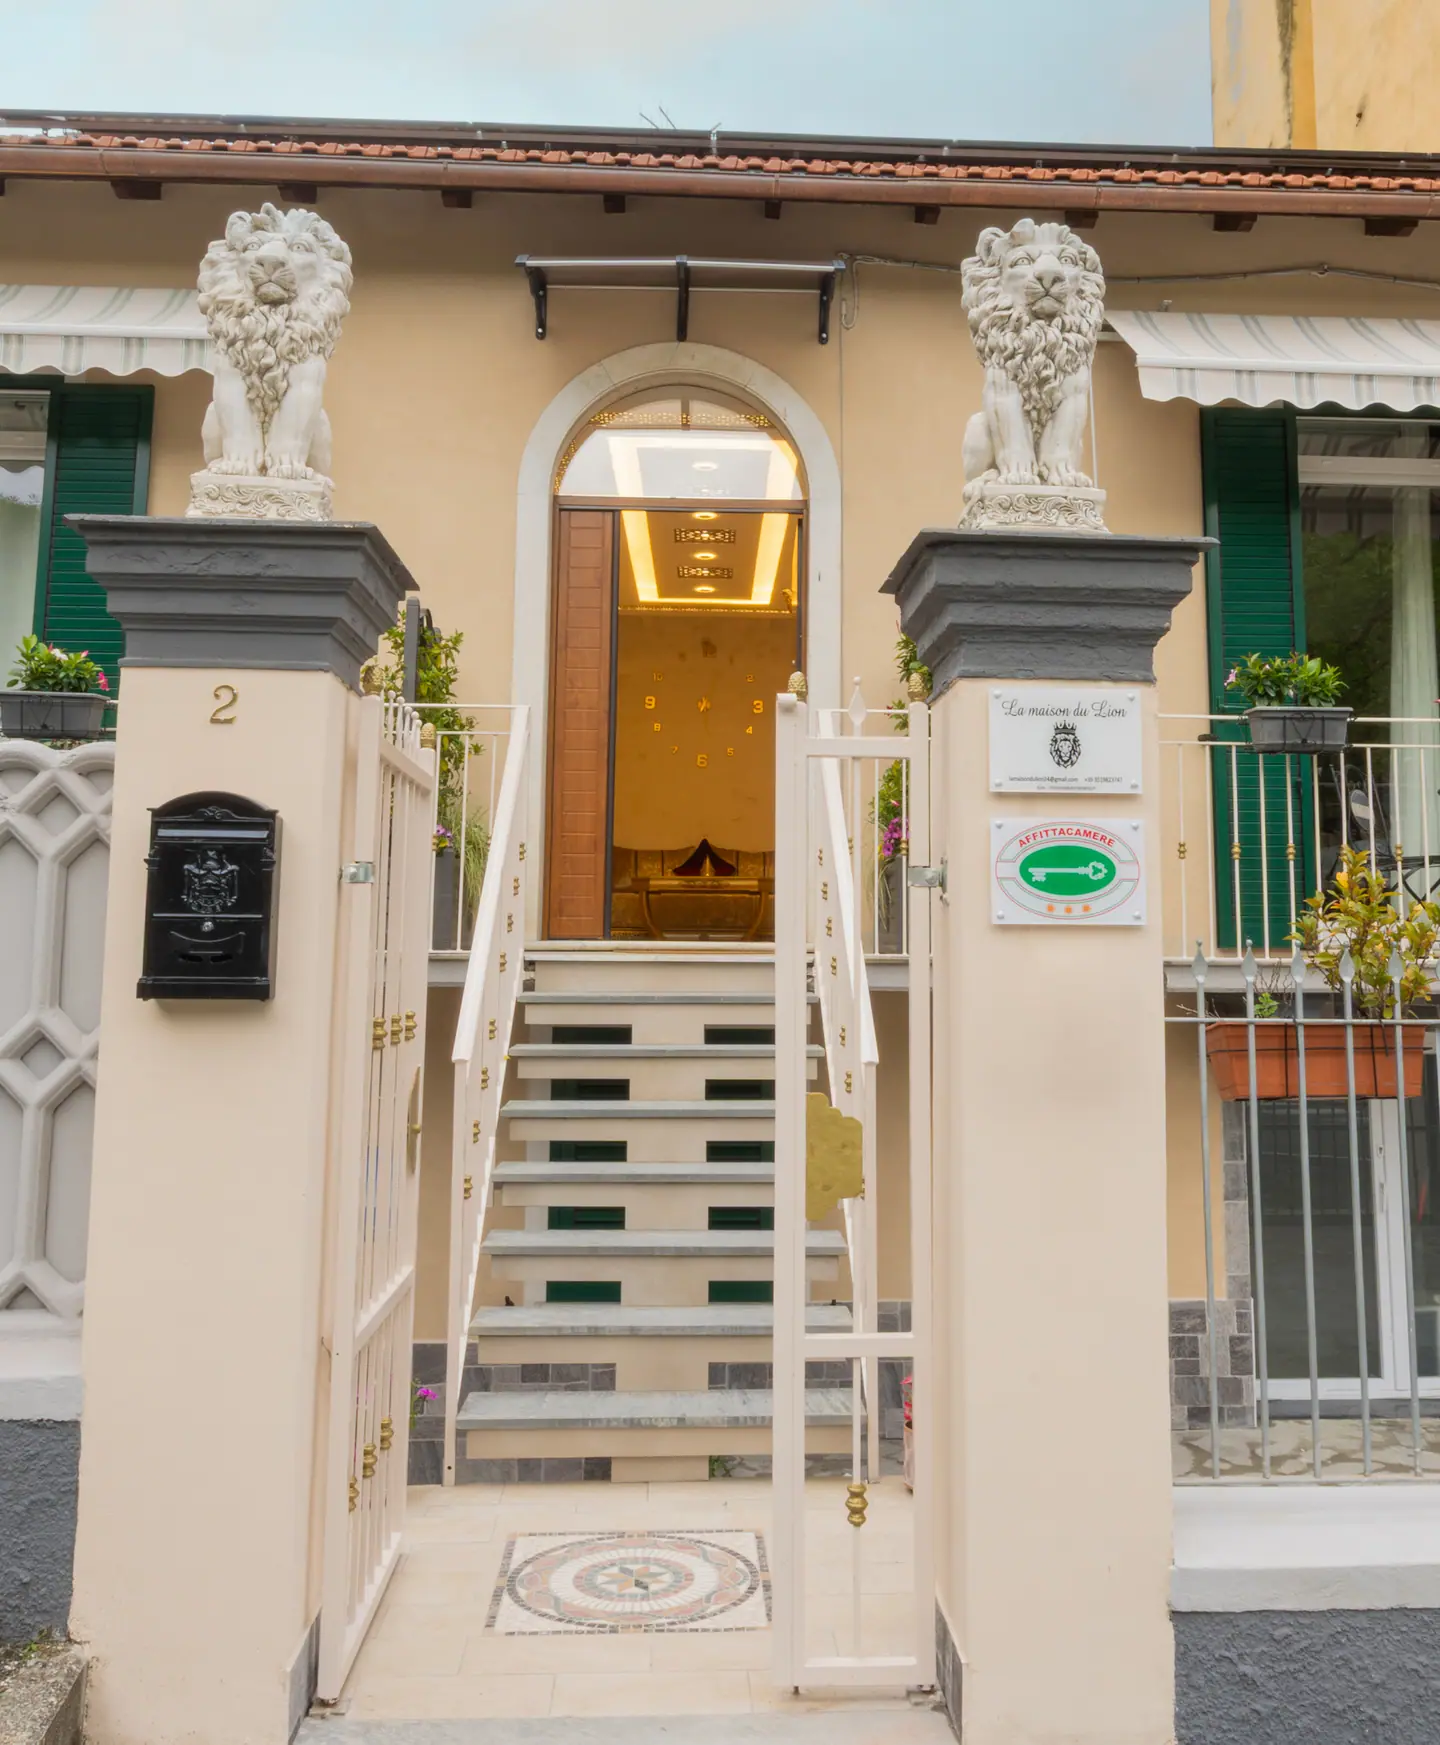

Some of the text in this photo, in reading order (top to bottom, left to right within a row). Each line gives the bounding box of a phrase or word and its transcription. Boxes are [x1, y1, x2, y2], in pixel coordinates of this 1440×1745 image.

[653, 673, 664, 681] 10
[746, 674, 754, 682] 2
[210, 684, 239, 724] 2
[644, 696, 656, 709] 9
[753, 700, 764, 714] 3
[1002, 699, 1127, 718] La maison du Lion
[654, 723, 661, 731] 8
[745, 726, 753, 734] 4
[670, 746, 678, 754] 7
[727, 748, 734, 756] 5
[696, 754, 708, 767] 6
[1018, 828, 1116, 848] AFFITTACAMERE
